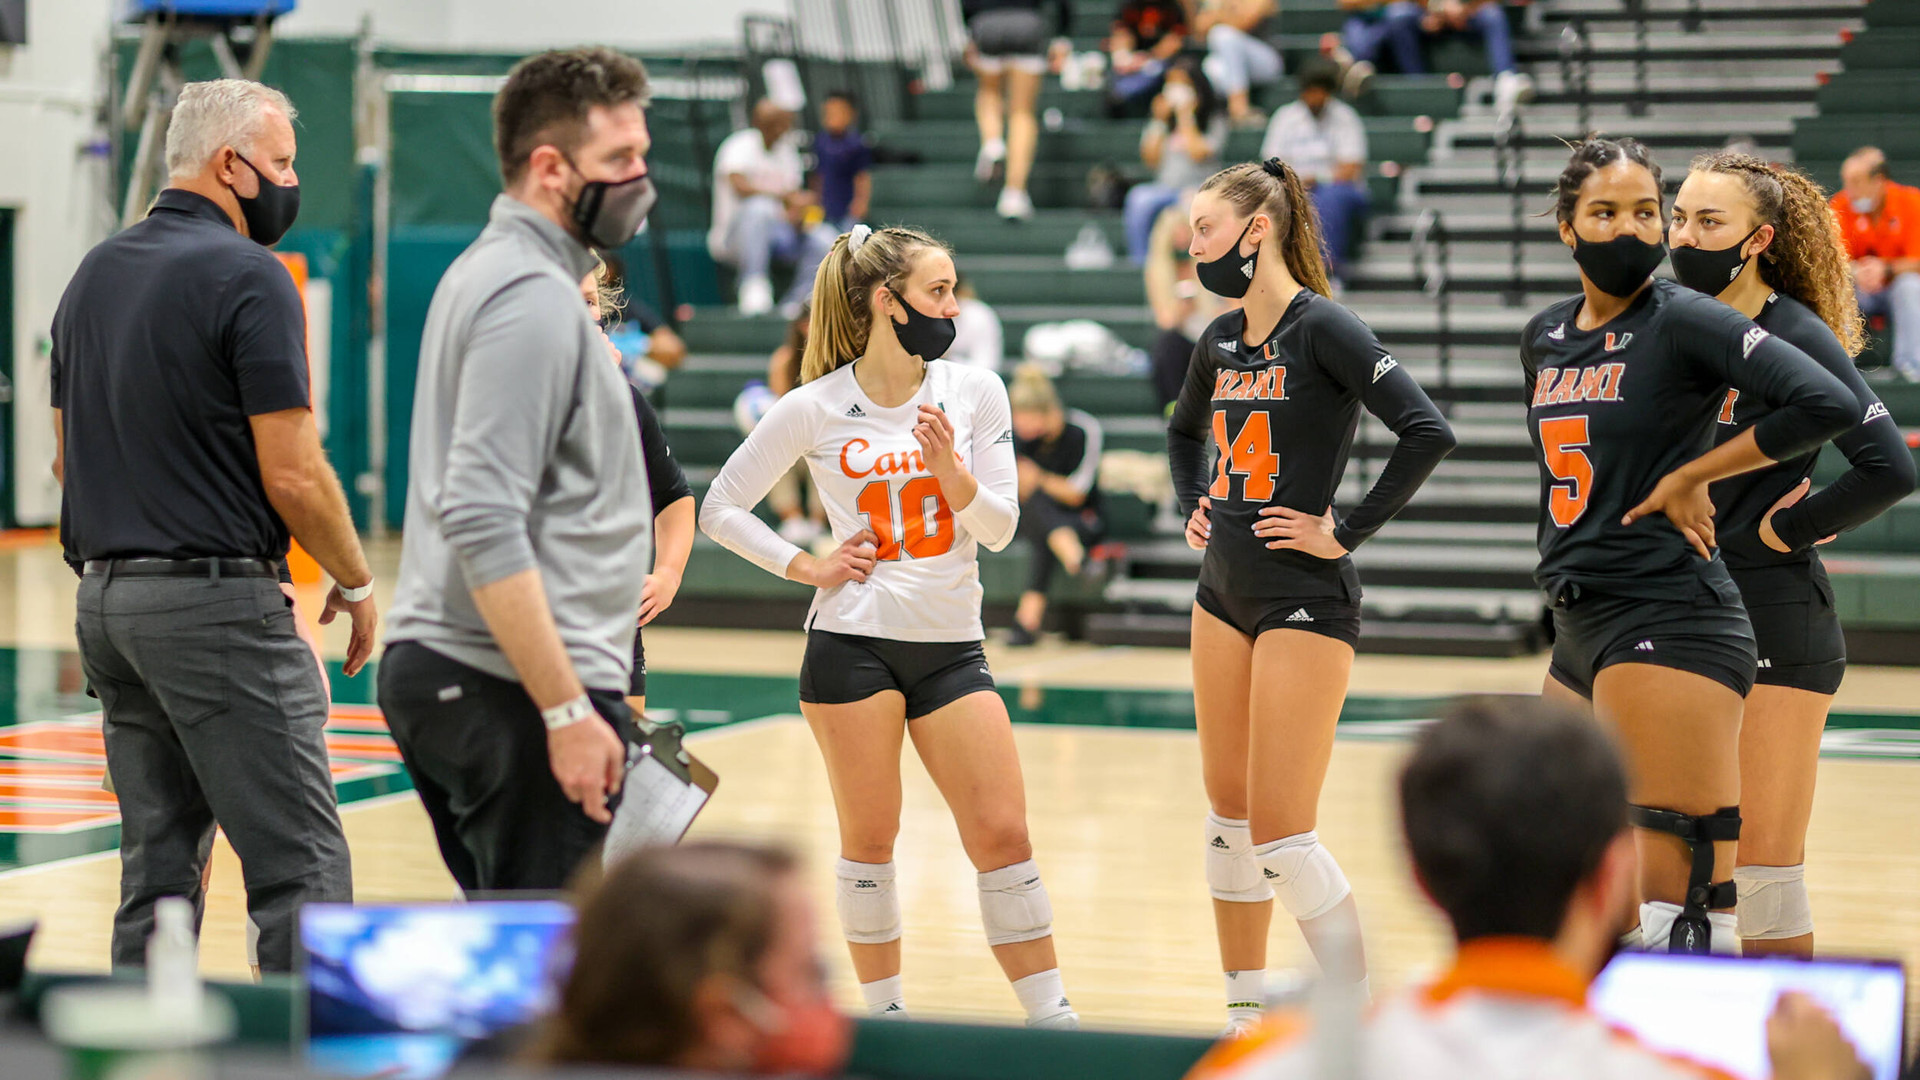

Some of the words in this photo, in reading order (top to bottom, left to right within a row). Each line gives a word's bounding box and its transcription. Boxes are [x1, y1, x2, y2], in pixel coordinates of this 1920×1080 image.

[1263, 340, 1280, 360] U
[1210, 366, 1287, 401] MIAMI
[1531, 363, 1626, 408] MIAMI
[1208, 409, 1279, 502] 14
[1539, 416, 1594, 528] 5
[855, 476, 956, 562] 10
